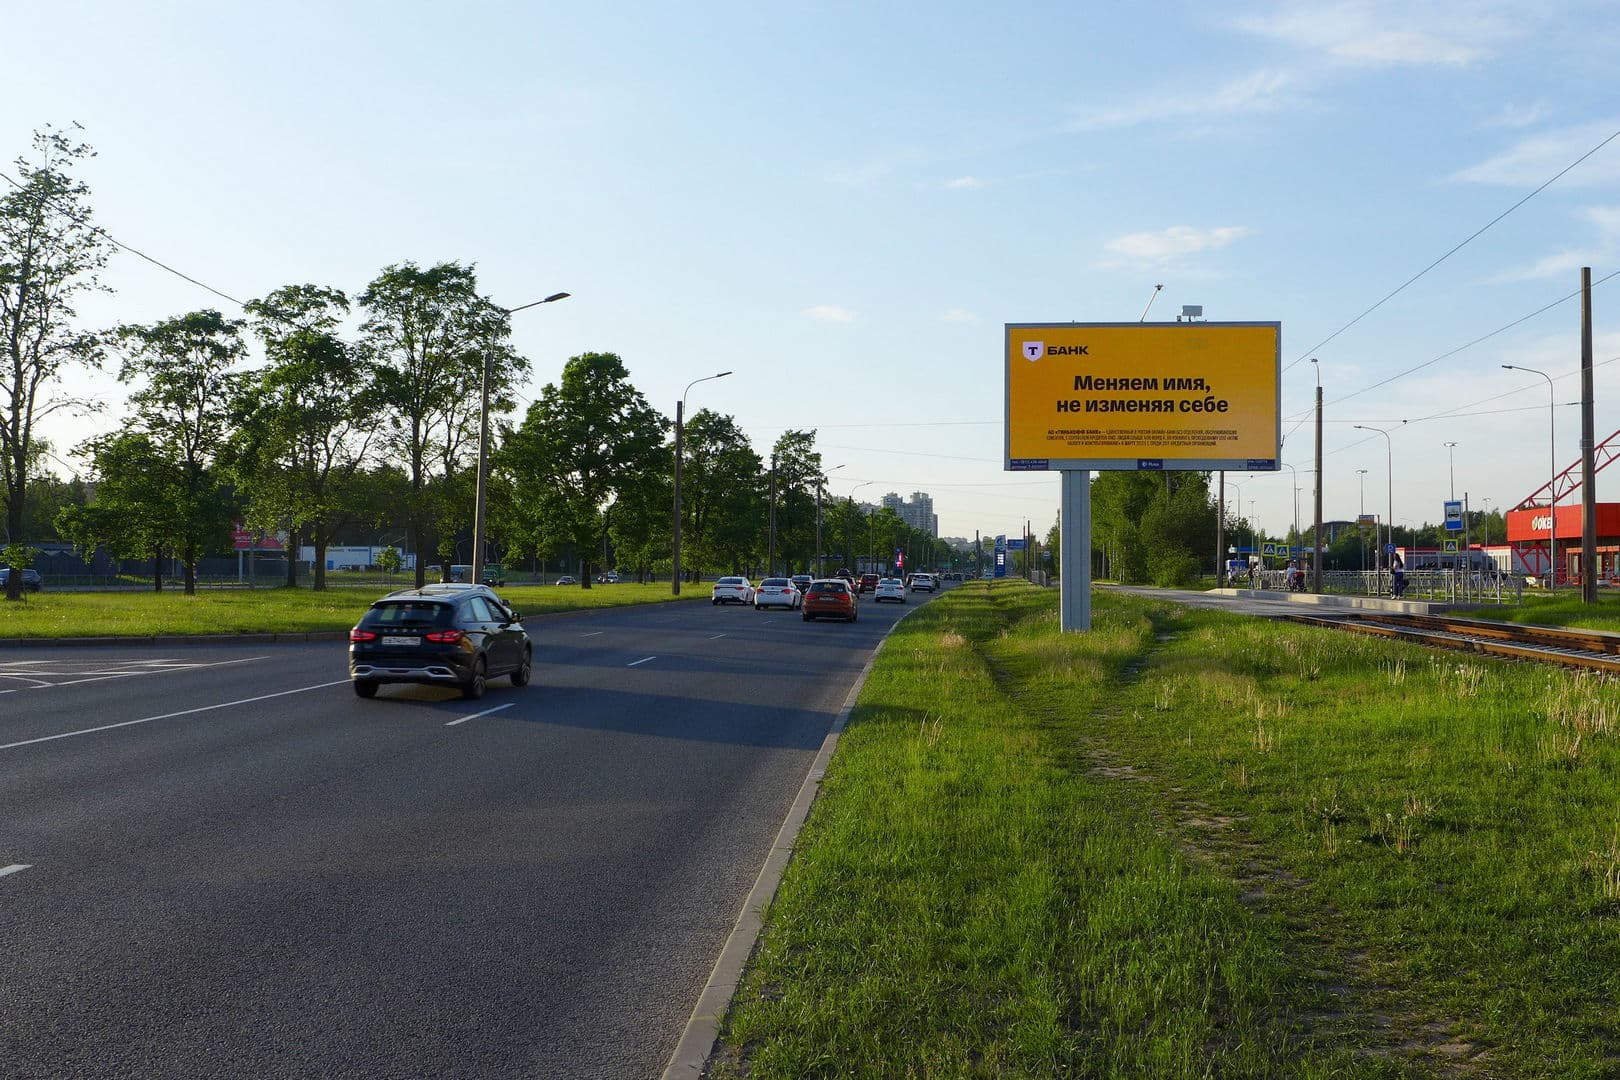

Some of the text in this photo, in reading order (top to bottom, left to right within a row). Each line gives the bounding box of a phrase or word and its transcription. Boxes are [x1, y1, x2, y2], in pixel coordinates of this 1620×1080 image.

[1047, 345, 1088, 355] БАНК
[1074, 375, 1211, 393] Меняем имя,
[1056, 395, 1229, 412] не изменяя себе
